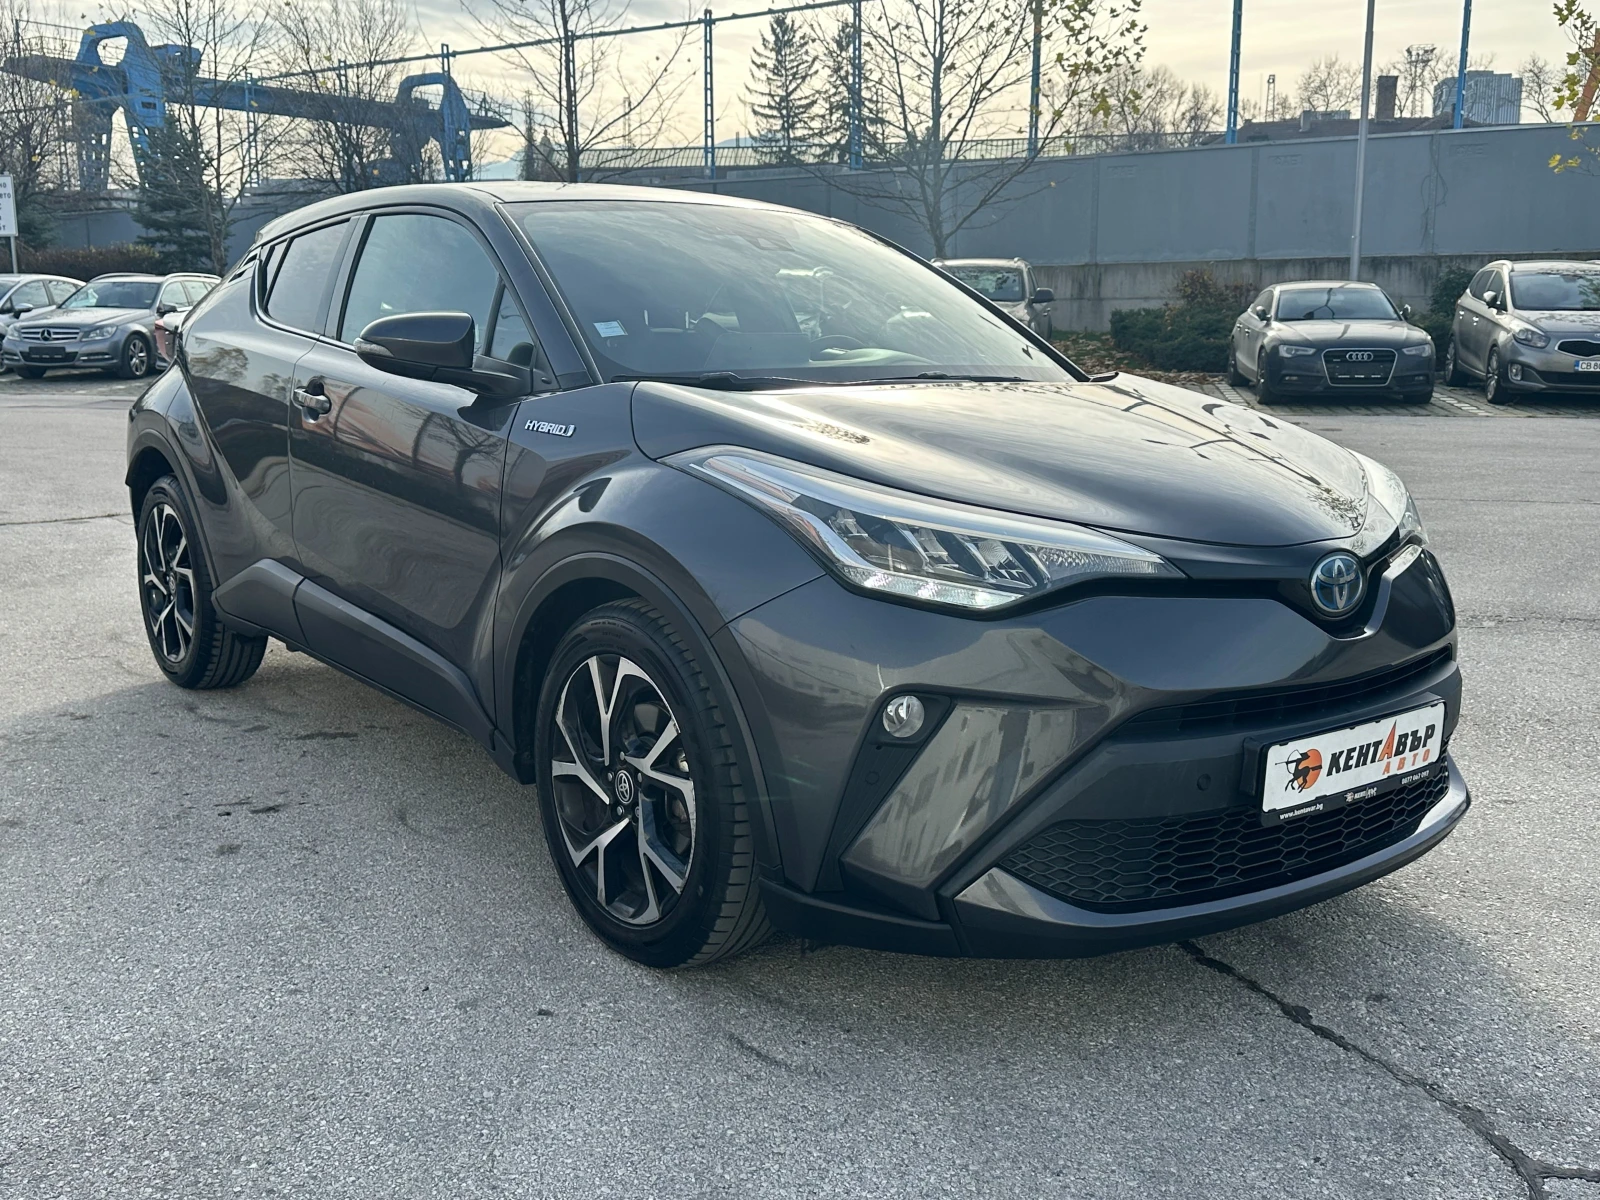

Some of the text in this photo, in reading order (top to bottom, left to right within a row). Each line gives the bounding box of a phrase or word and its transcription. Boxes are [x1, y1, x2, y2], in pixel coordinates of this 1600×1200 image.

[524, 419, 566, 435] HYBRID
[1326, 719, 1436, 777] КЕНТАВЪР
[1382, 749, 1430, 775] АВТО
[1279, 804, 1324, 820] www.kentavar.bg
